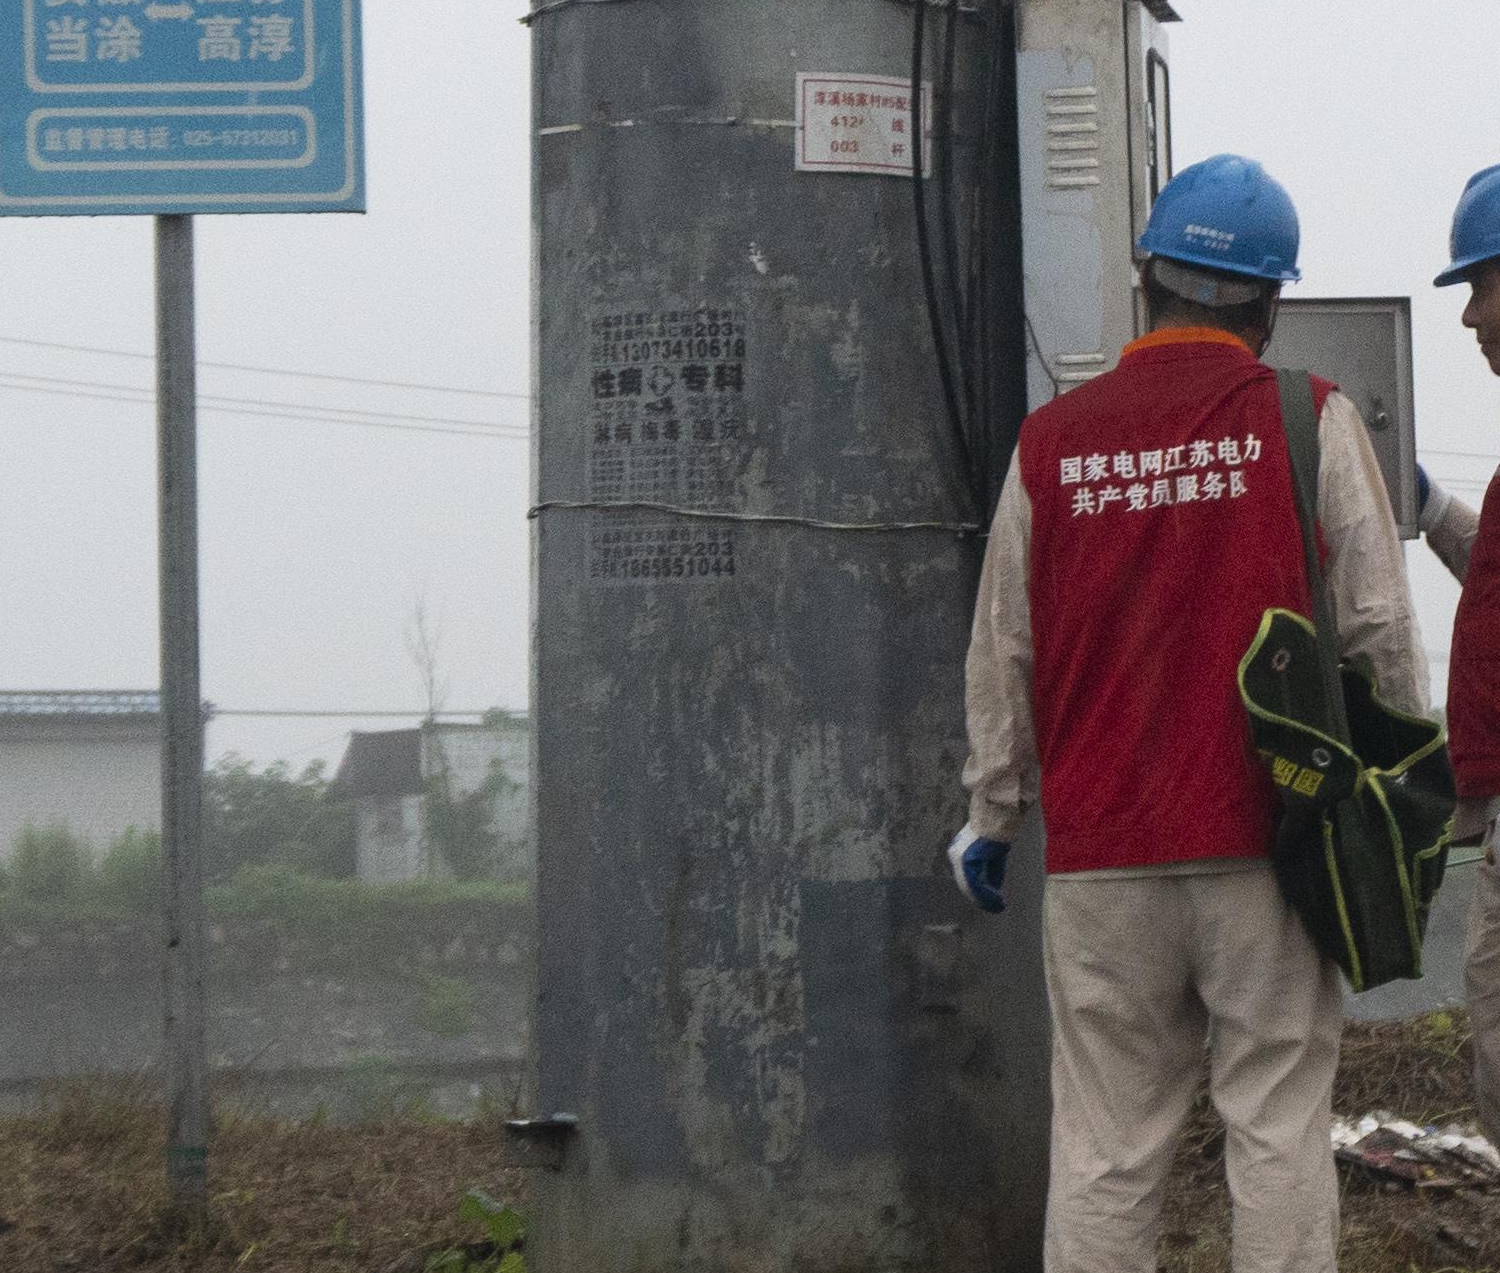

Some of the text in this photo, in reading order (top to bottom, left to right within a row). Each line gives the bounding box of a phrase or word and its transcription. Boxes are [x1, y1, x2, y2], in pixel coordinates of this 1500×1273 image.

[44, 13, 297, 64] 当涂 高淳
[1059, 433, 1263, 486] 国家电网江苏电力
[1071, 470, 1248, 518] 共产党员服务队
